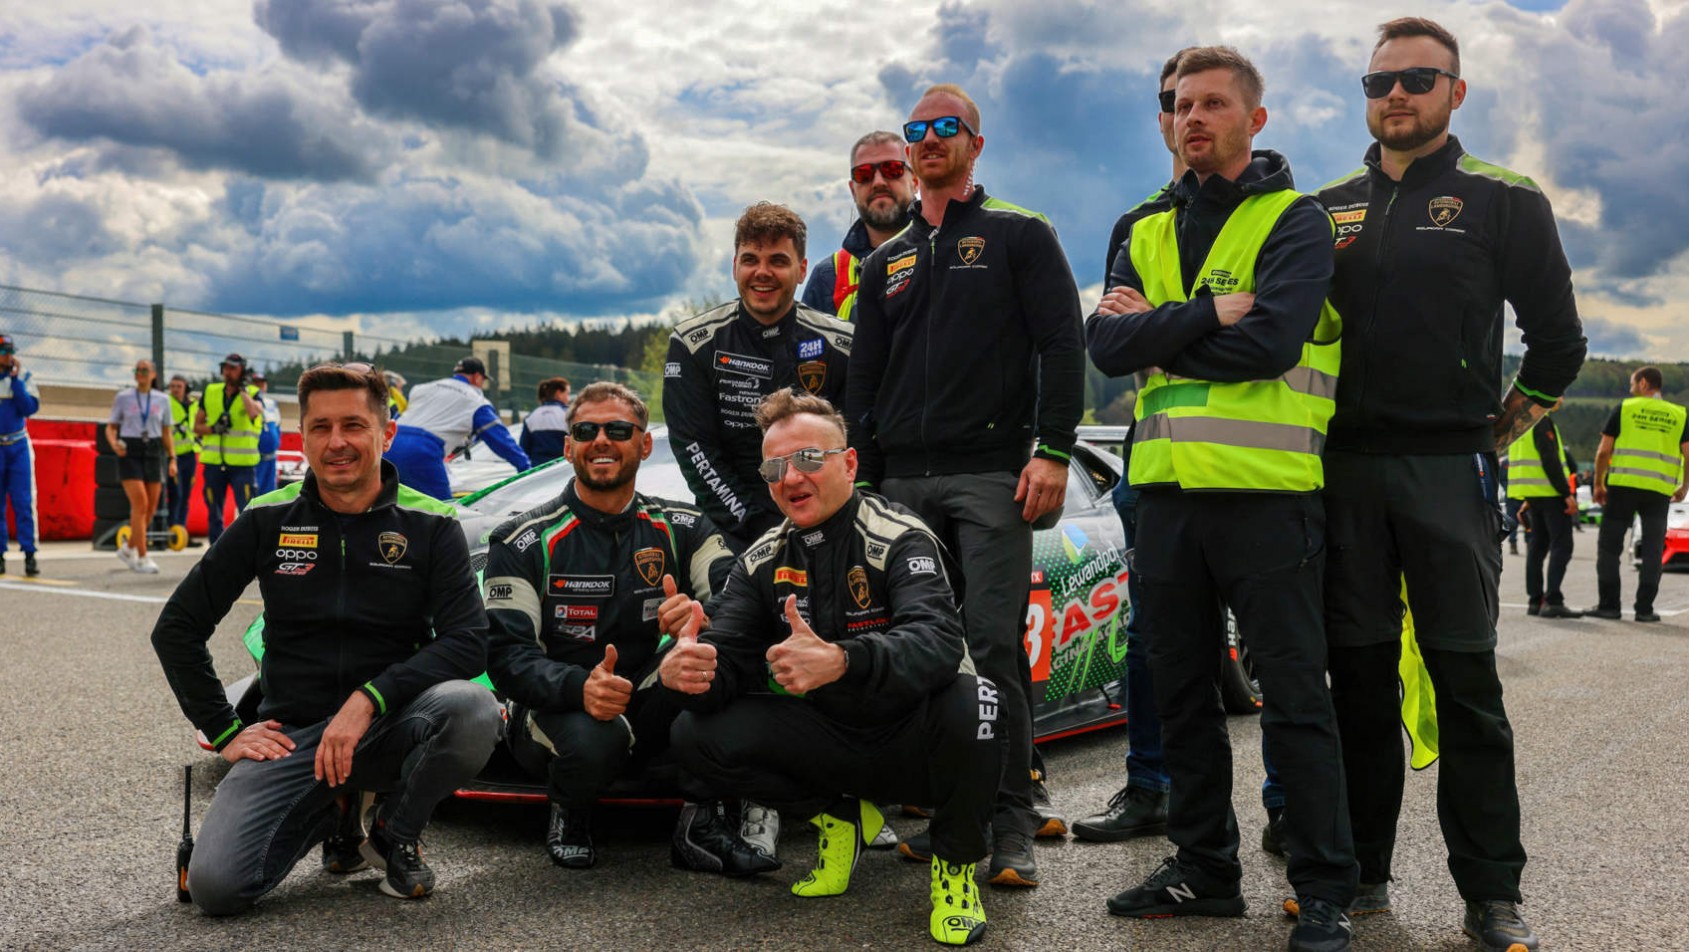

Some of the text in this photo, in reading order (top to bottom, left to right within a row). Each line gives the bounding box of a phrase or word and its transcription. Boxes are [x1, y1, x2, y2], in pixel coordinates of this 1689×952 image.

[690, 329, 709, 344] OMP
[763, 327, 779, 338] OMP
[800, 339, 822, 353] 24H
[664, 365, 682, 376] OMP
[719, 392, 761, 404] Fastron
[685, 441, 747, 522] PERTAMINA
[672, 514, 695, 525] OMP
[516, 531, 537, 550] OMP
[804, 533, 824, 545] OMP
[275, 548, 318, 561] oppo
[750, 546, 772, 563] OMP
[867, 544, 884, 557] OMP
[908, 559, 936, 572] OMP
[1060, 540, 1120, 597] Lewandpol
[489, 586, 513, 598] OMP
[569, 608, 596, 617] TOTAL
